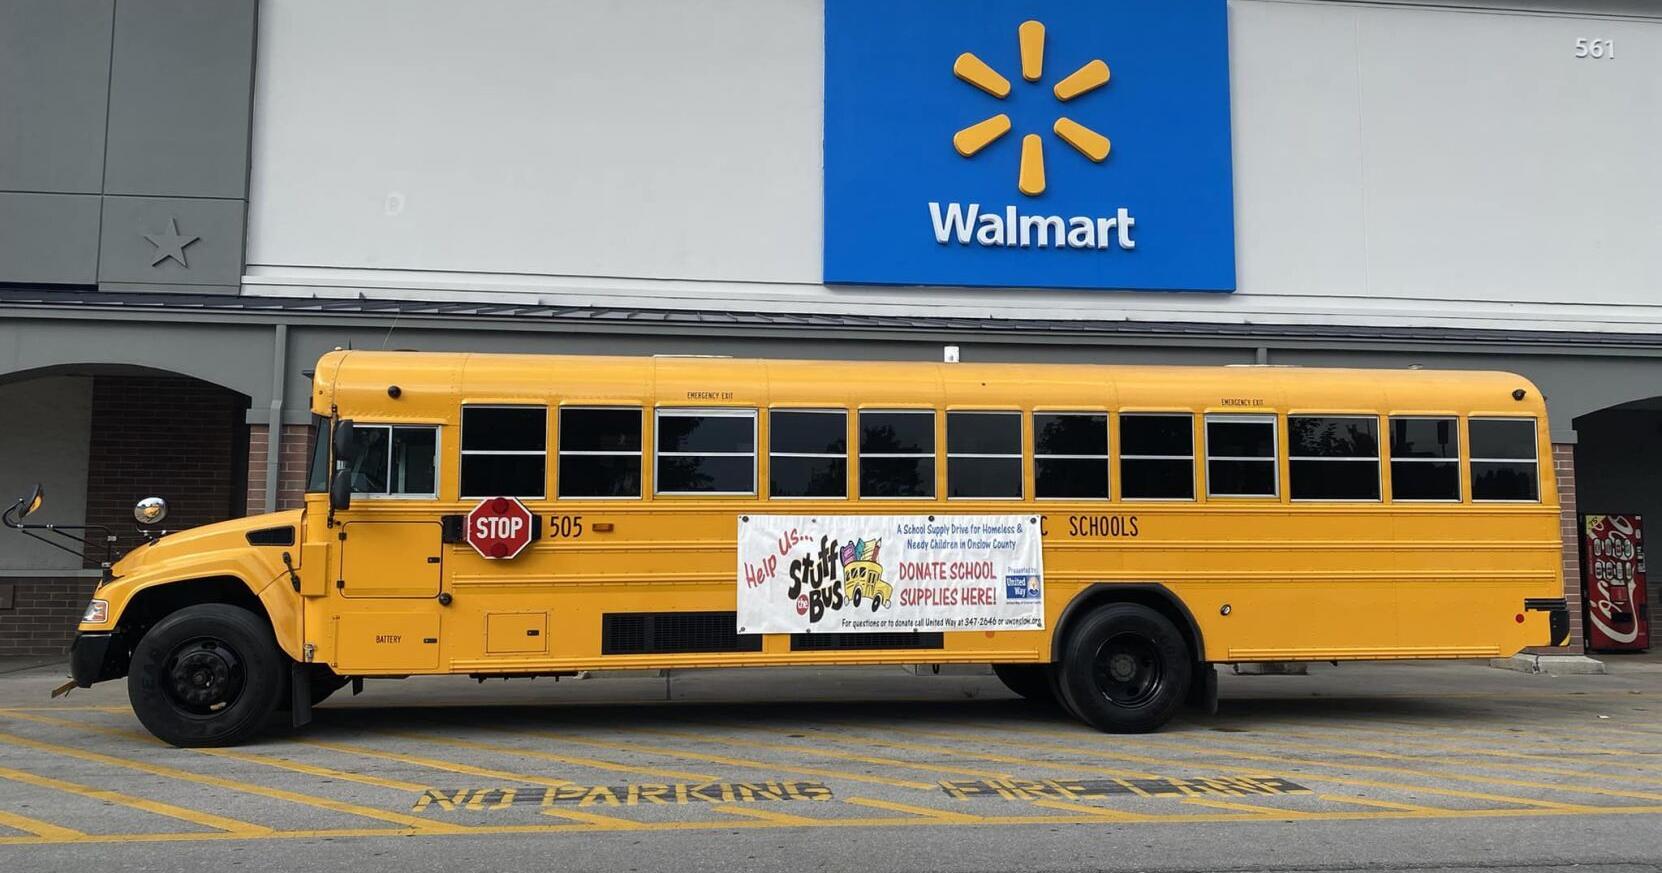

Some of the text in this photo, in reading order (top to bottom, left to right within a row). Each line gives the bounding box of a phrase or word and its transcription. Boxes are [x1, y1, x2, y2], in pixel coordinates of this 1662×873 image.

[1576, 38, 1614, 59] 561
[928, 202, 1136, 249] Walmart
[687, 391, 733, 400] EMERGENCY EXIT
[476, 516, 523, 539] STOP
[550, 516, 583, 538] 505
[897, 523, 1023, 537] A School Supply Drive for Homeless &
[1069, 515, 1138, 536] SCHOOLS
[907, 539, 1017, 551] Needy Children in Onslow County
[744, 554, 777, 589] Help
[788, 534, 839, 600] Stuff
[899, 561, 997, 580] DONATE SCHOOL
[1007, 577, 1026, 586] United
[900, 587, 997, 606] SUPPLIES HERE!
[1014, 587, 1026, 598] Way
[842, 618, 851, 627] For
[852, 618, 880, 630] questions
[881, 619, 887, 627] or
[888, 618, 894, 627] to
[895, 618, 913, 627] donate
[914, 618, 924, 627] call
[926, 618, 943, 627] United
[945, 617, 956, 628] Way
[957, 617, 963, 626] at
[964, 617, 996, 626] 347-2646
[998, 617, 1004, 625] or
[376, 635, 401, 643] BATTERY
[412, 781, 833, 812] NO PARKING
[937, 778, 1108, 800] FIRE
